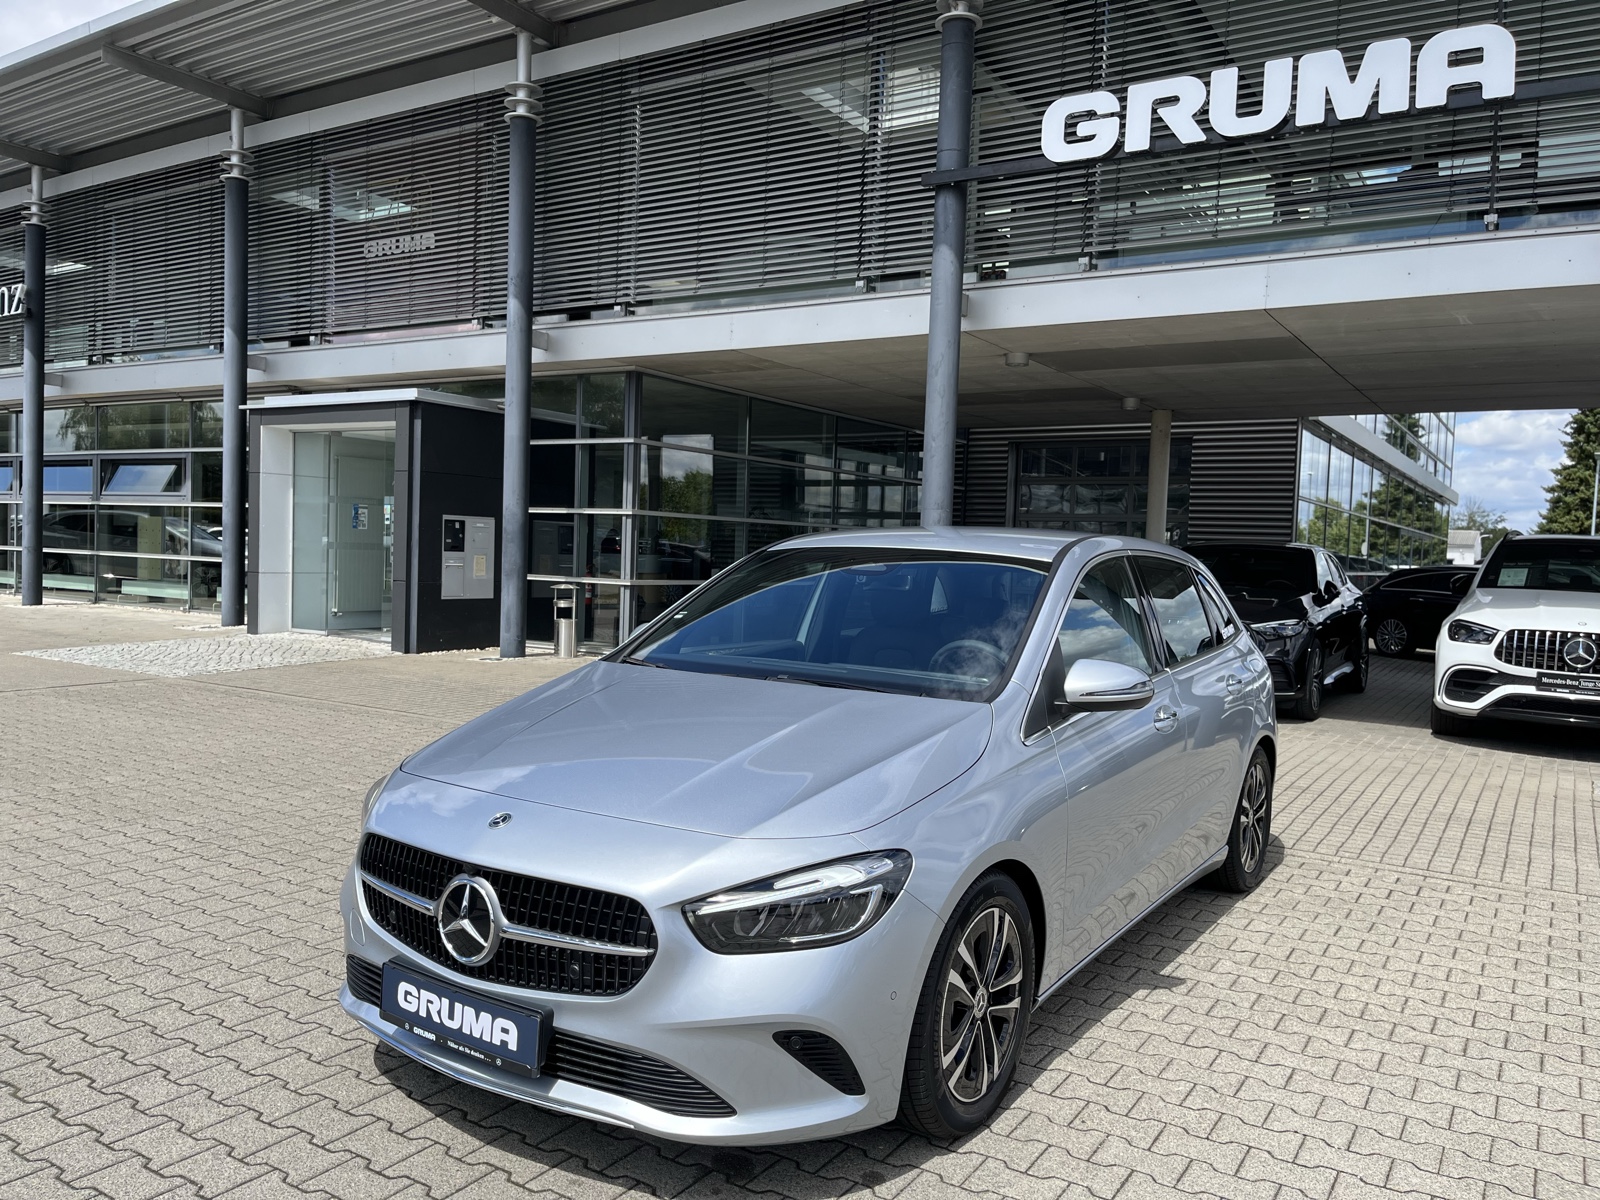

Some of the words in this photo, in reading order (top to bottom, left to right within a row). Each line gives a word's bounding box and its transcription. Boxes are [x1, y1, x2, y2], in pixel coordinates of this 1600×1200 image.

[1041, 23, 1517, 163] GRUMA
[364, 232, 435, 258] GRUMA
[1541, 677, 1579, 686] Mercedes-Benz
[397, 981, 518, 1051] GRUMA
[413, 1026, 436, 1041] GRUMA
[933, 995, 942, 1069] MICHELIN
